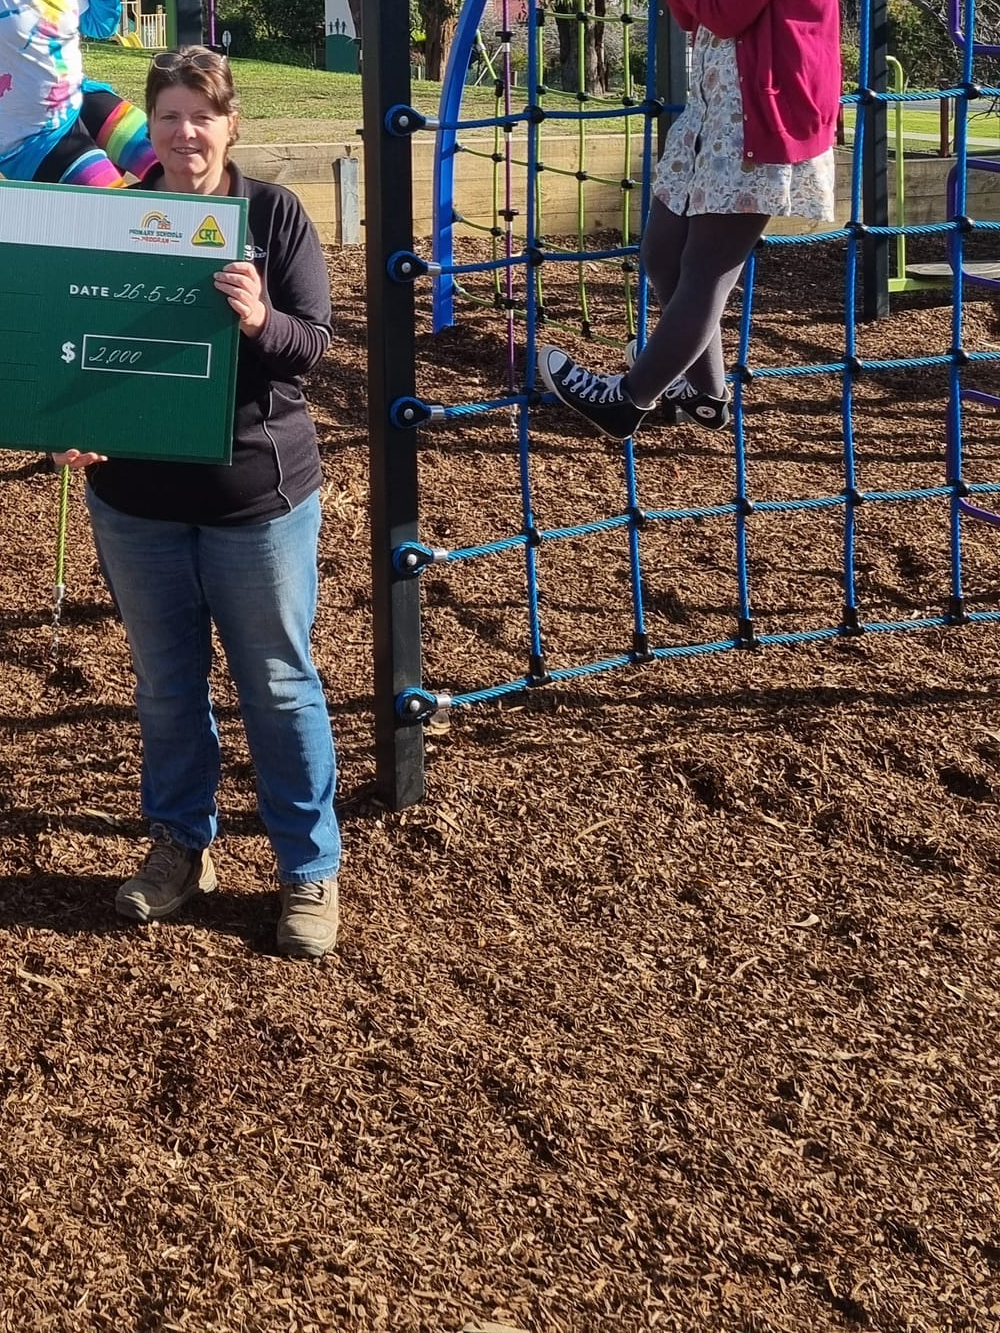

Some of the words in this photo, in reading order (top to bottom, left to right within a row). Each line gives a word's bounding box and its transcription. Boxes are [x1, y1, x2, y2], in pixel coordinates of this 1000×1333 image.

[129, 228, 154, 237] PRIMARY
[156, 231, 183, 239] SCHOOLS
[199, 228, 218, 241] CRT
[69, 284, 110, 297] DATE
[60, 341, 76, 364] $
